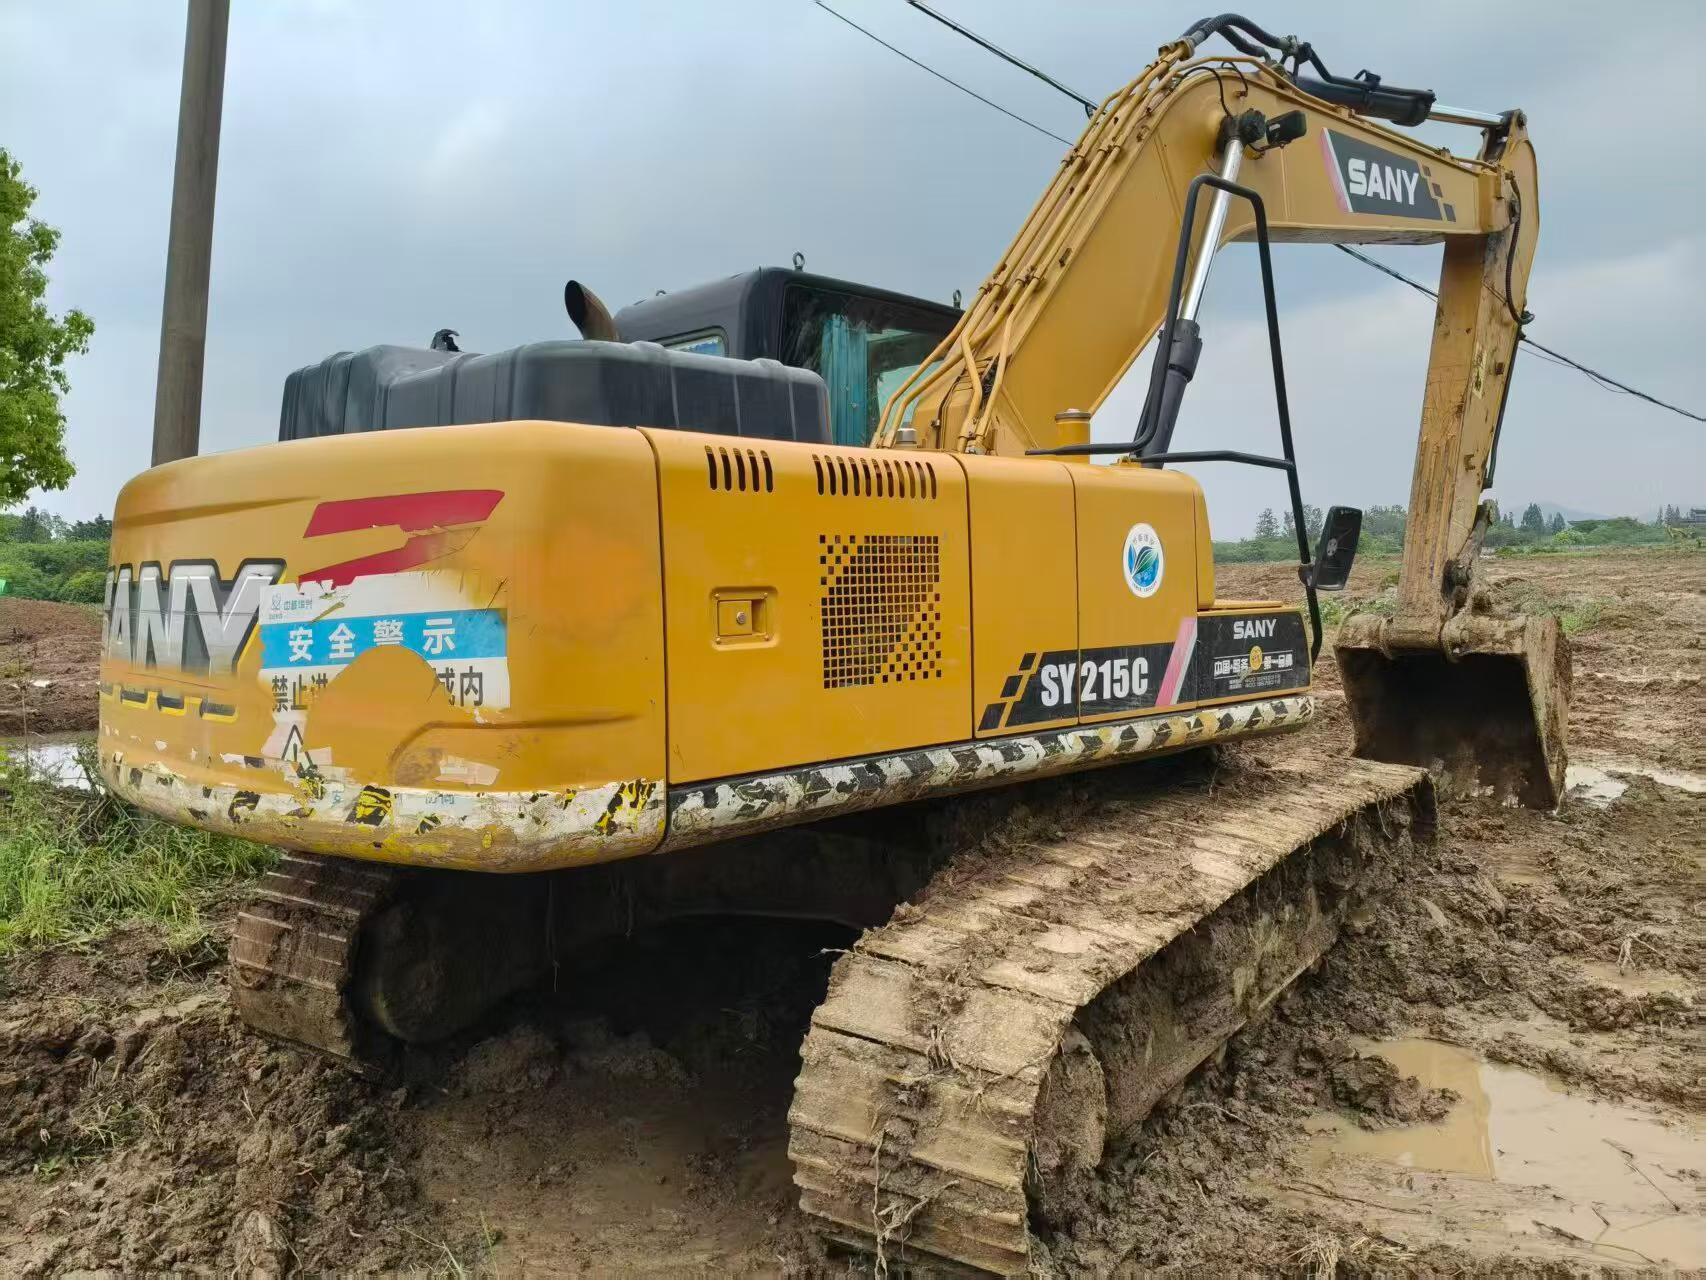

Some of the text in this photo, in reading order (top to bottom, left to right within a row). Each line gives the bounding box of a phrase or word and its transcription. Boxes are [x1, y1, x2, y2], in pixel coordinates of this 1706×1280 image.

[1348, 158, 1419, 205] SANY
[288, 617, 456, 662] 安全警示
[1233, 618, 1277, 640] SANY
[1041, 657, 1148, 707] SY215C
